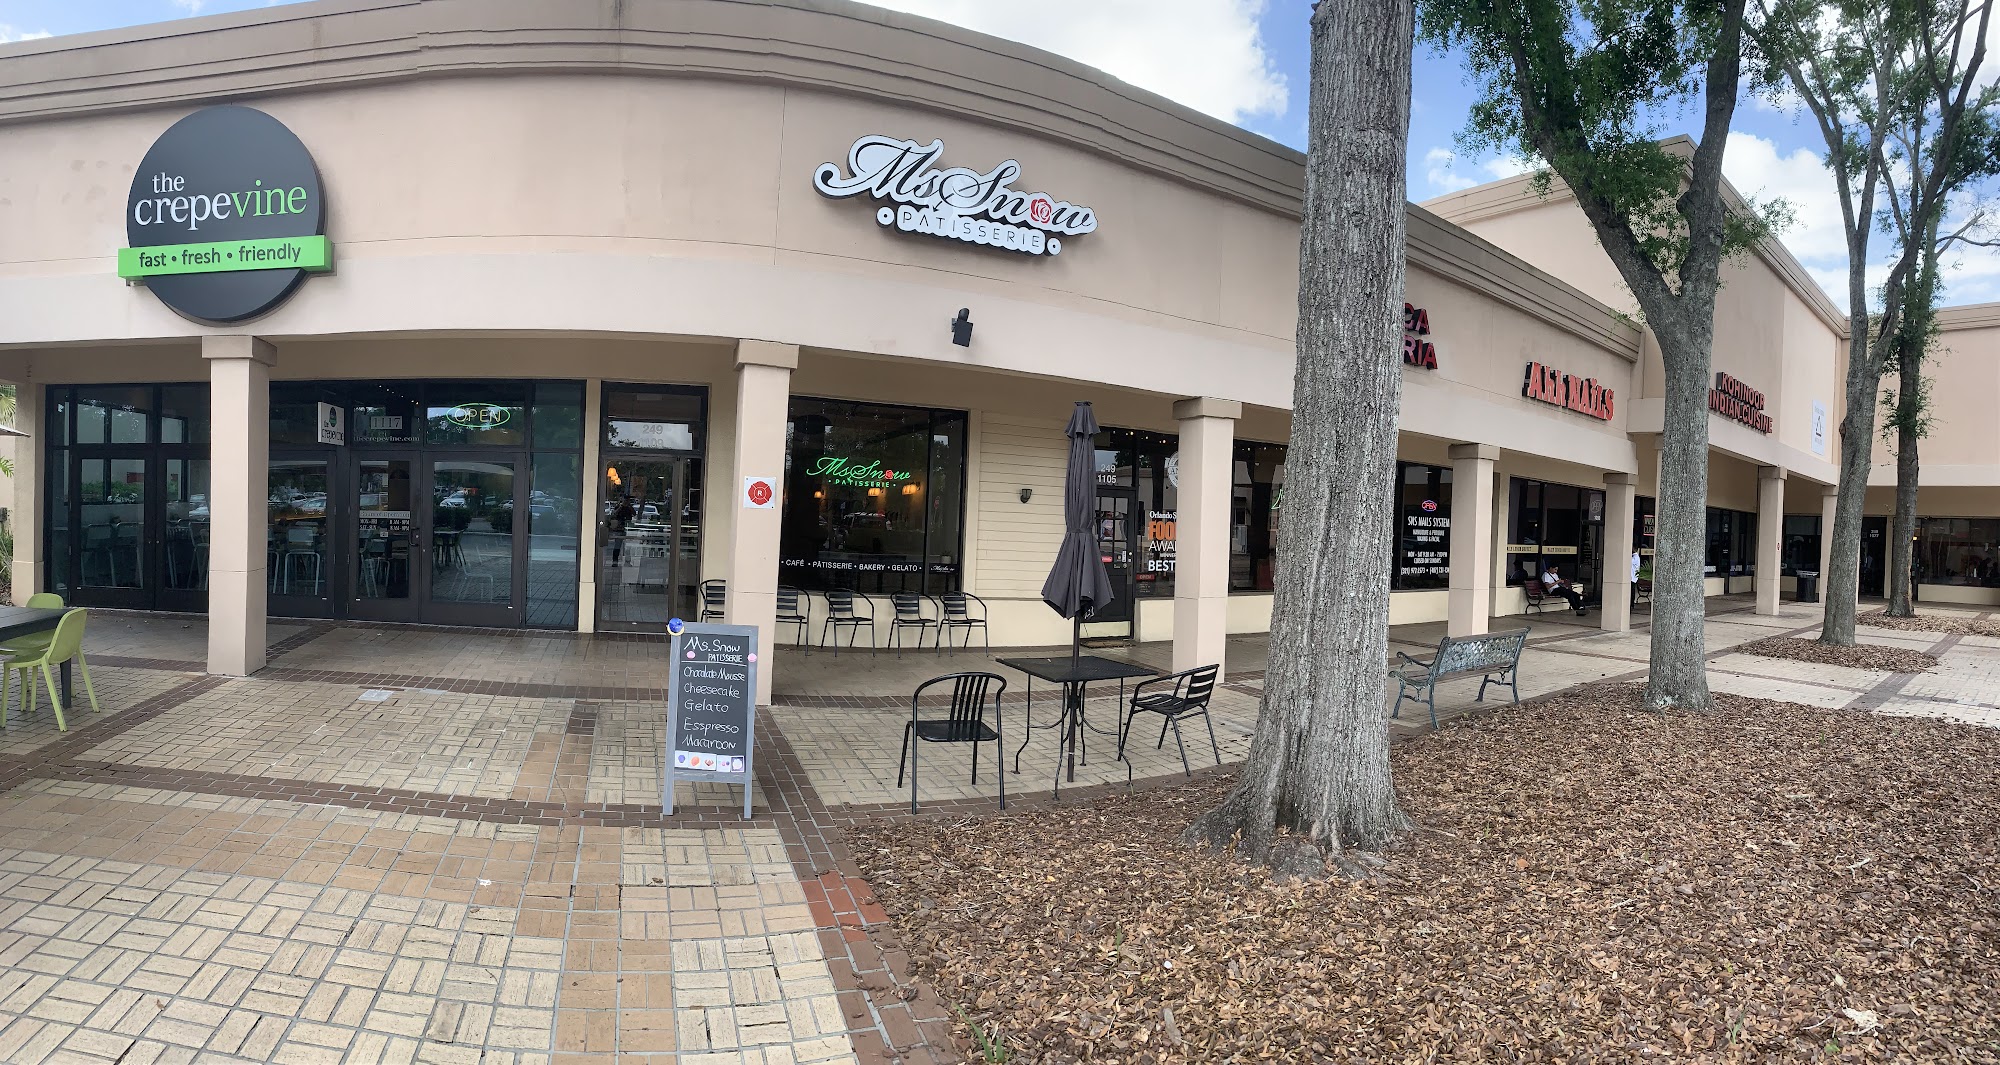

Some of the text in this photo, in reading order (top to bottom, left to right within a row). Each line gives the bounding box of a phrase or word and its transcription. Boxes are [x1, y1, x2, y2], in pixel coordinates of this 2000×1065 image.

[151, 172, 185, 193] the
[134, 180, 307, 231] crepevine
[139, 243, 301, 267] fast fresh friendly
[1404, 302, 1430, 335] CA
[1404, 334, 1438, 370] RIA
[1718, 372, 1765, 410] KOHINOOR
[454, 407, 501, 423] OPEN
[1708, 388, 1773, 434] INDIAN CUISINE
[373, 417, 401, 428] 1117
[642, 424, 664, 434] 249
[1100, 464, 1116, 473] 249
[1097, 474, 1117, 483] 1105
[1149, 511, 1173, 519] Orlando
[1418, 516, 1432, 527] NAILS
[1433, 517, 1450, 527] SYSTEM
[1148, 521, 1176, 541] FOO
[1148, 540, 1176, 551] AWA
[786, 558, 805, 567] CAFÉ
[859, 563, 886, 571] BAKERY
[1148, 560, 1176, 572] BEST
[684, 636, 740, 652] Ms. Snow
[708, 653, 743, 663] PATISSERIE
[683, 665, 745, 681] Chocolate Mousse
[684, 682, 740, 699] Cheesecake
[684, 699, 729, 713] Gelato
[683, 716, 740, 736] Esspresso
